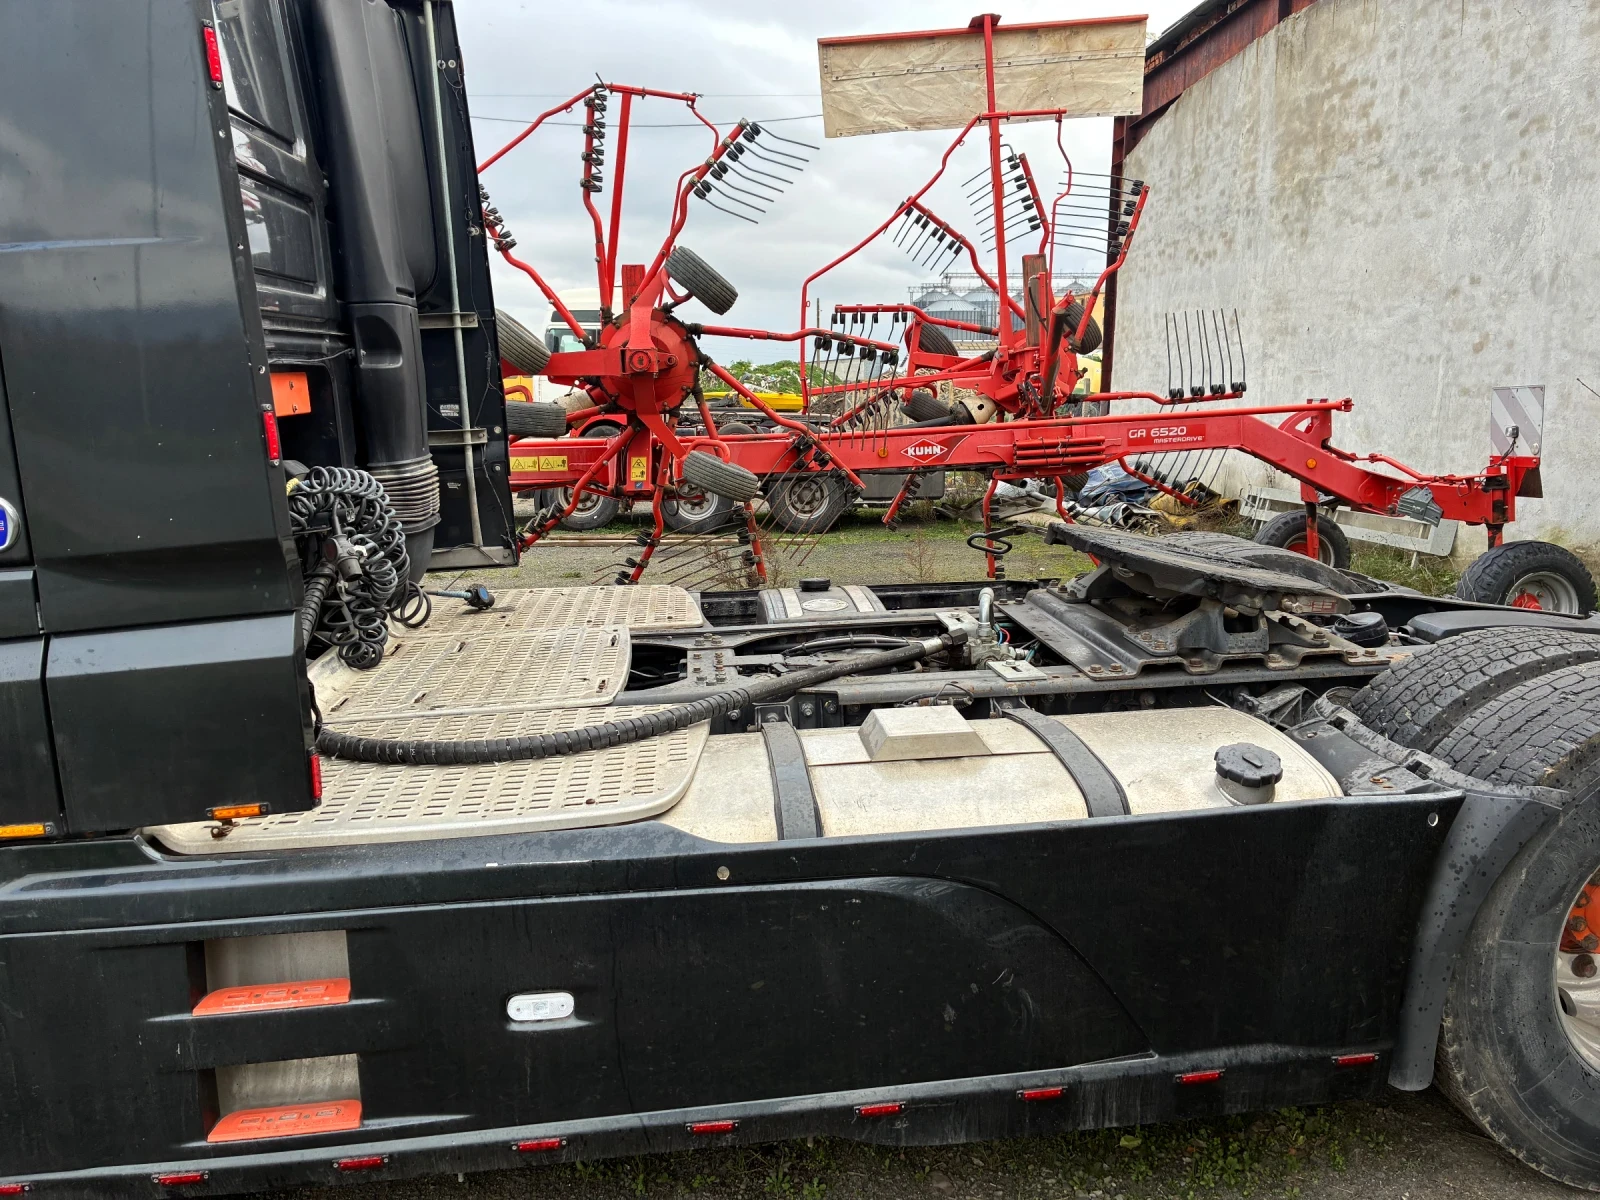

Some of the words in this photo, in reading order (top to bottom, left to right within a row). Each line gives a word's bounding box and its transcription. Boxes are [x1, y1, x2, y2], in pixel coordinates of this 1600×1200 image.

[1128, 428, 1147, 439] GA
[1150, 425, 1187, 437] 6520
[1153, 435, 1204, 444] MASTERDRIVE
[907, 445, 941, 456] KUHN
